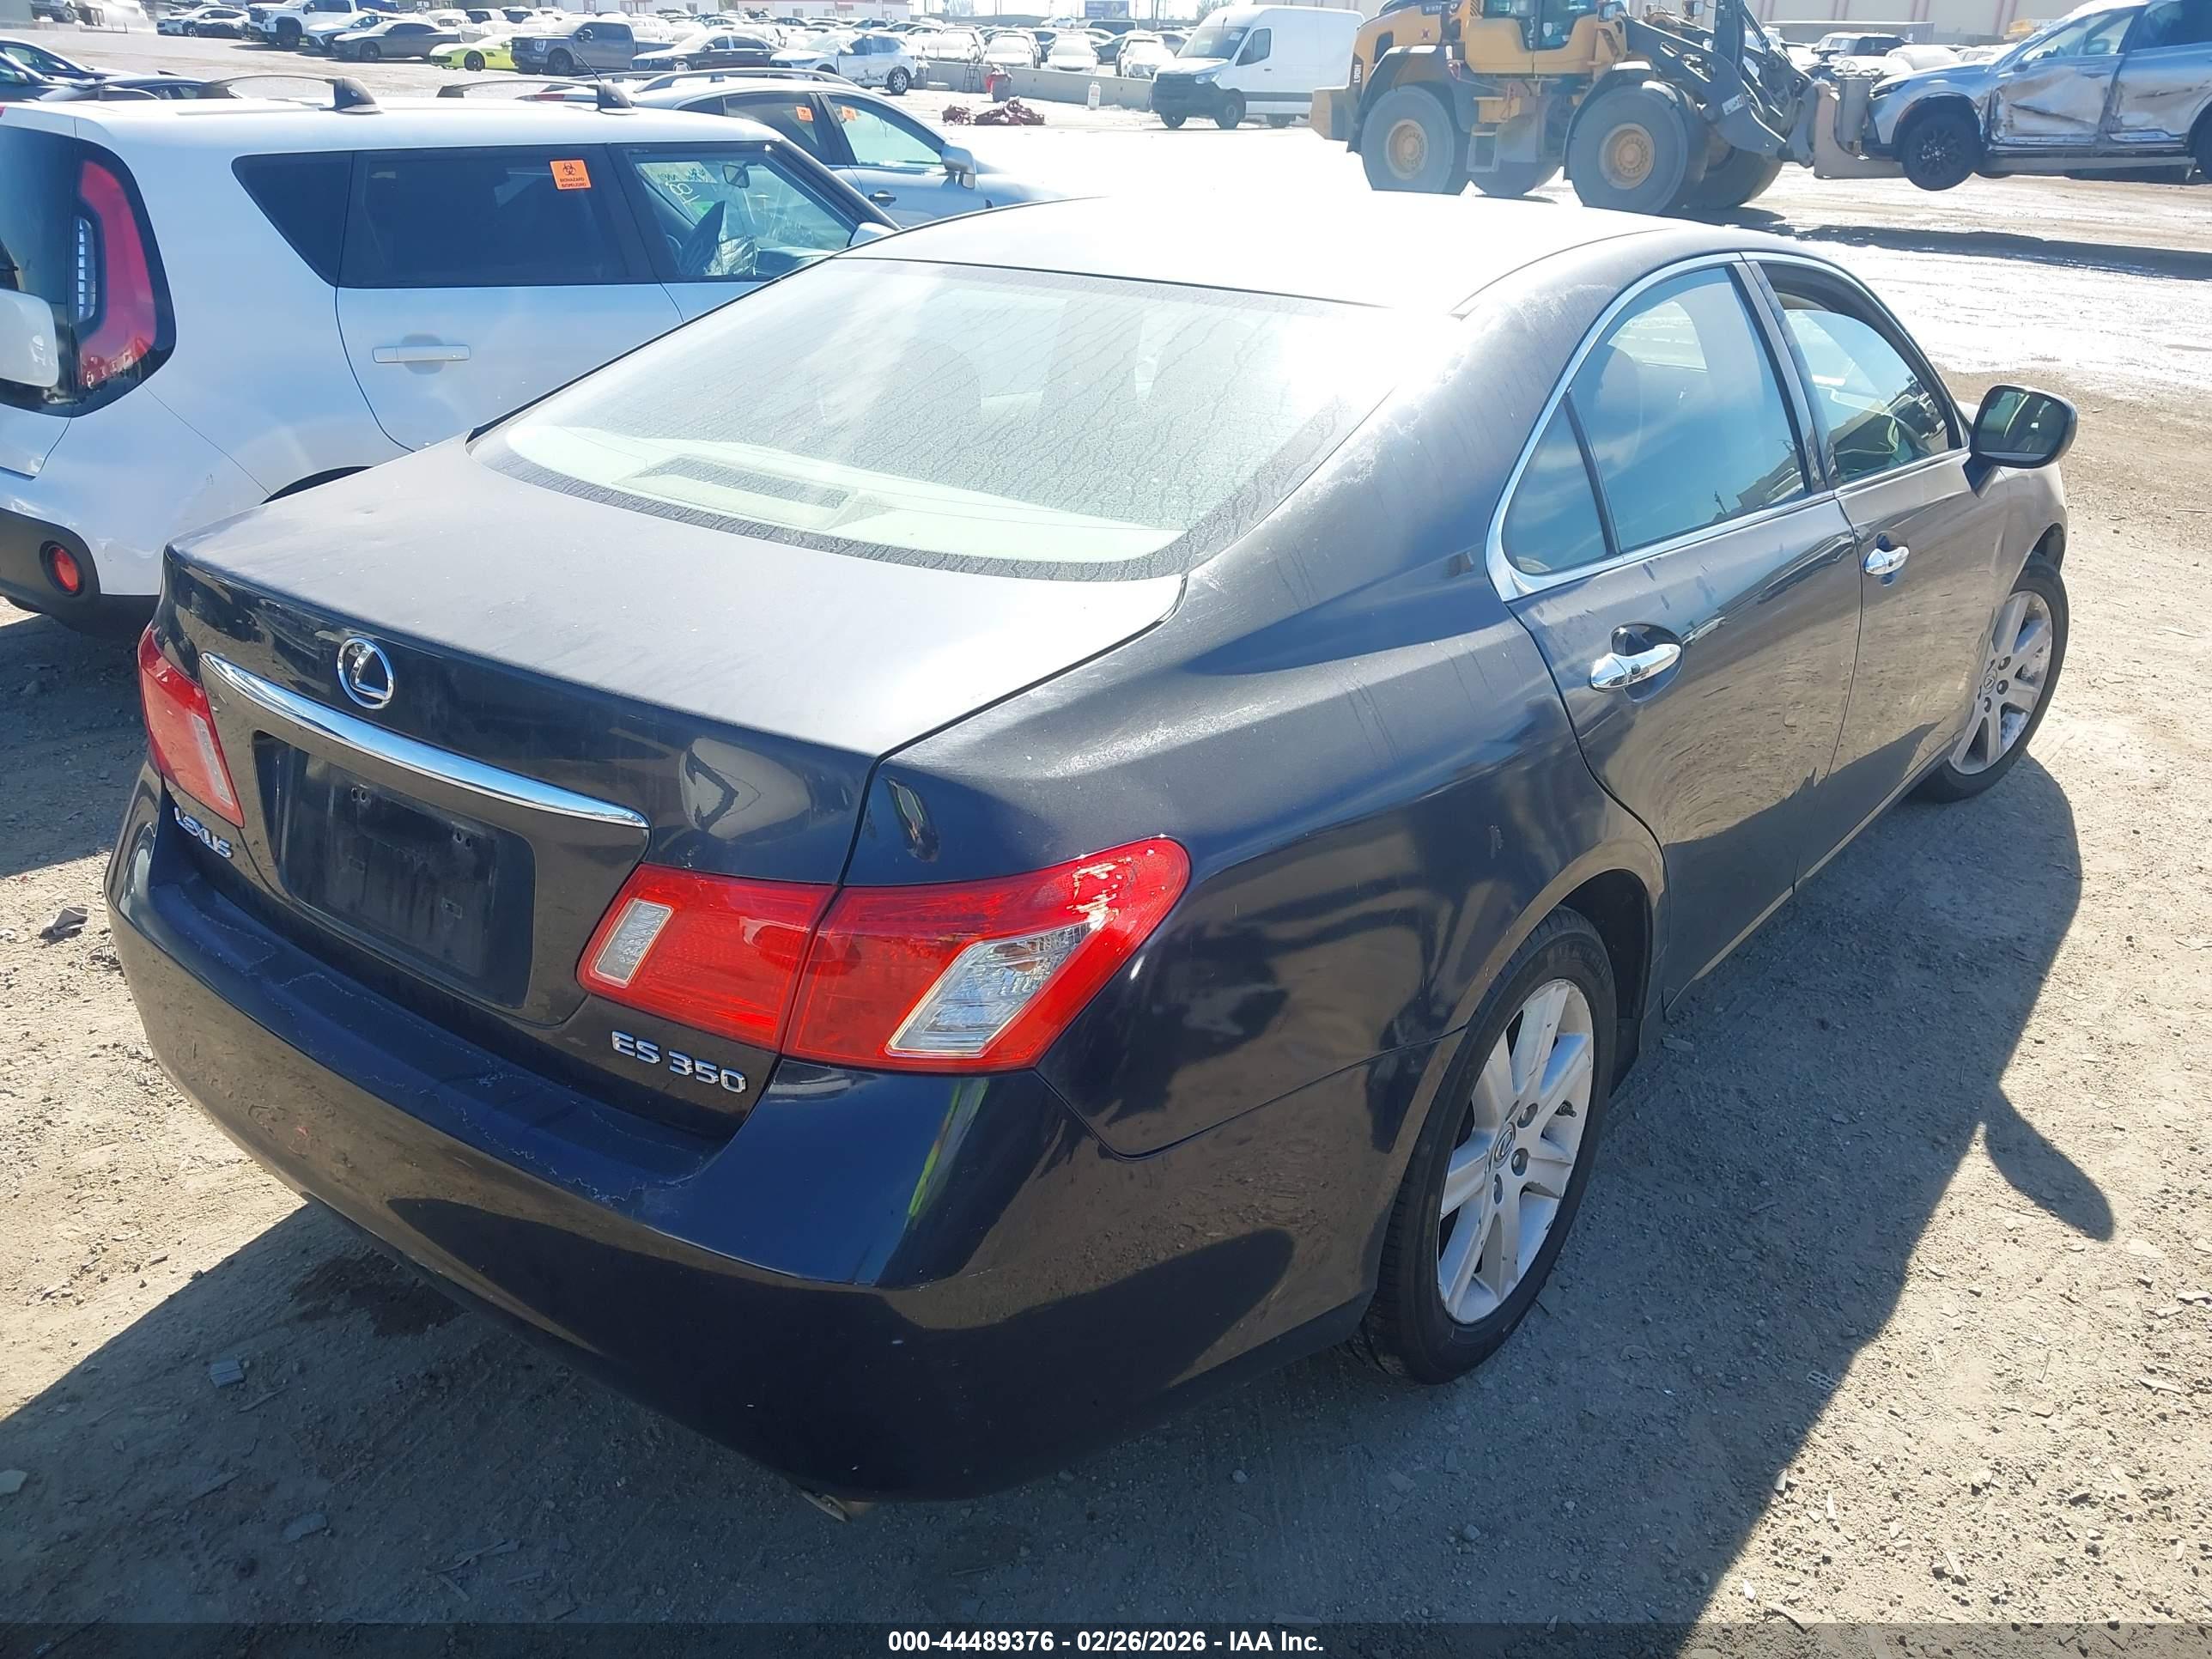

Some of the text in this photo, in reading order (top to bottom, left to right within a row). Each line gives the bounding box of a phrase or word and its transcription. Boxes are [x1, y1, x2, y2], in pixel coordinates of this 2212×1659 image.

[173, 807, 232, 857] LEXUS
[611, 1030, 746, 1093] ES 350
